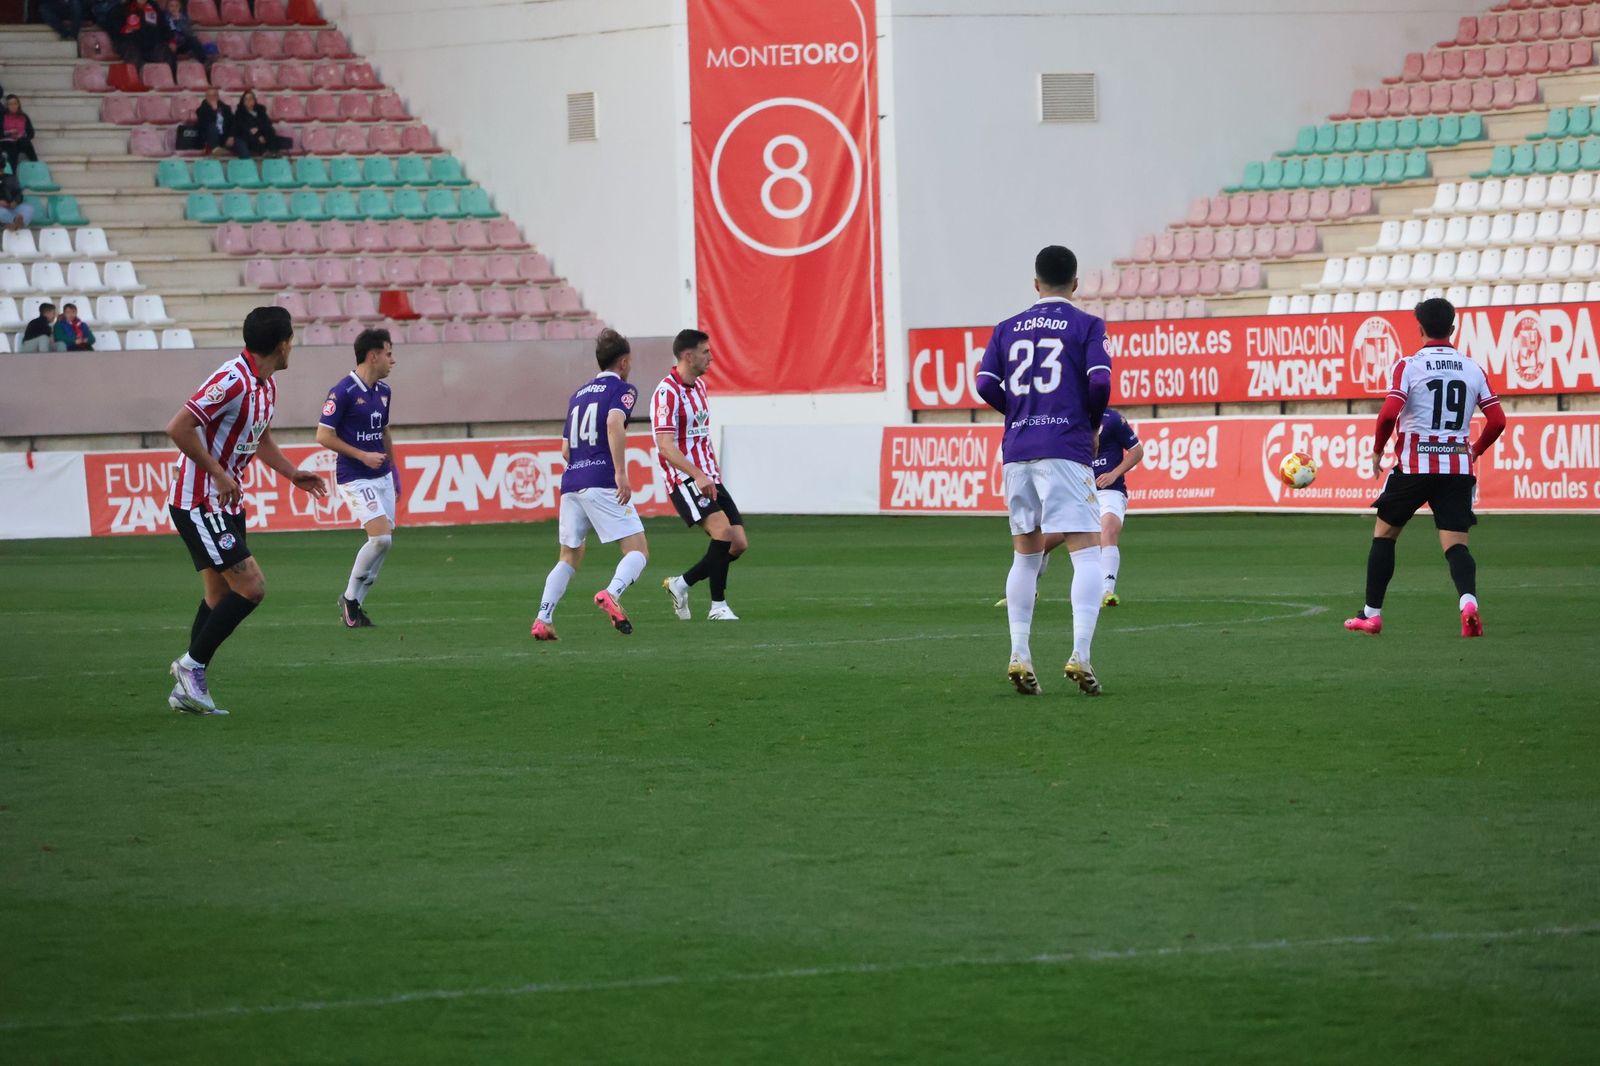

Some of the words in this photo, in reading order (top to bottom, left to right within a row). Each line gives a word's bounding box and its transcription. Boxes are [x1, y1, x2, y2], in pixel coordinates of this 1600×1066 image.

[706, 41, 859, 69] MONTETORO
[761, 134, 812, 220] 8
[1013, 316, 1068, 332] J.CASADO
[1246, 318, 1345, 357] FUNDACIÓN
[1008, 338, 1064, 397] 23
[1120, 369, 1151, 399] 675
[1154, 367, 1185, 397] 630
[1189, 366, 1219, 396] 110
[1425, 360, 1463, 371] A.DAMAR
[1425, 378, 1467, 431] 19
[570, 402, 599, 449] 14
[892, 431, 988, 467] FUNDACIÓN
[1291, 423, 1399, 480] Freige
[1494, 424, 1533, 470] E.S.
[360, 487, 376, 501] 10
[1148, 489, 1174, 499] FOODS
[1176, 488, 1215, 499] COMPANY
[1336, 488, 1363, 499] FOODS
[1514, 473, 1588, 500] Morales
